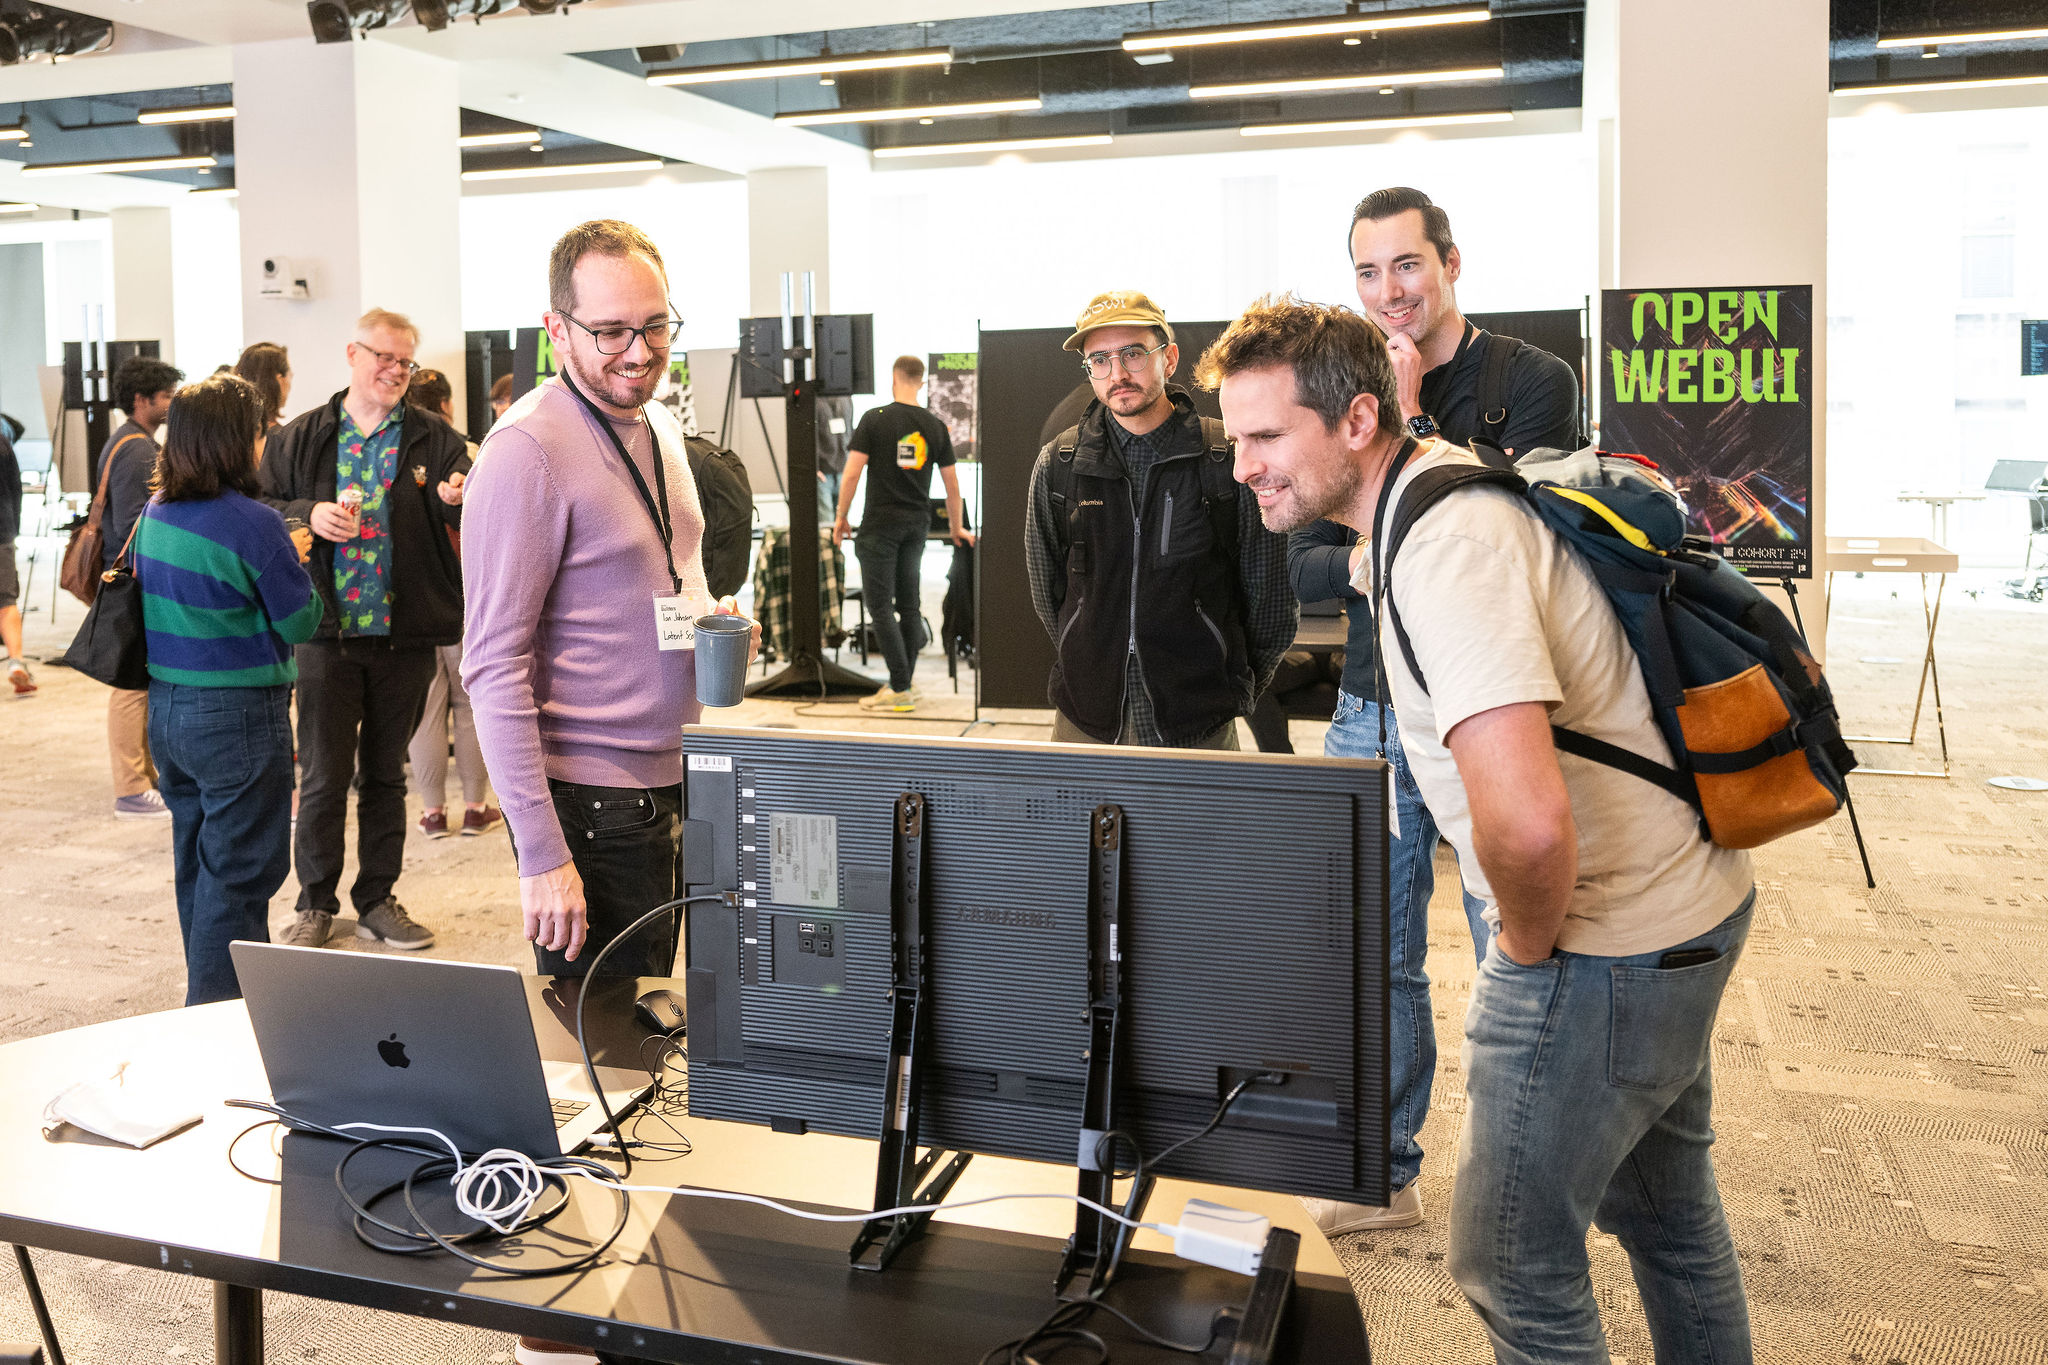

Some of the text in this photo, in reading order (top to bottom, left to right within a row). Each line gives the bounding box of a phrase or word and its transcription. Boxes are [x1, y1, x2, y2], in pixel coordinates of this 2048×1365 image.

[1632, 290, 1778, 345] OPEN
[1611, 348, 1800, 402] WEBUI
[1738, 547, 1807, 559] COHORT 24
